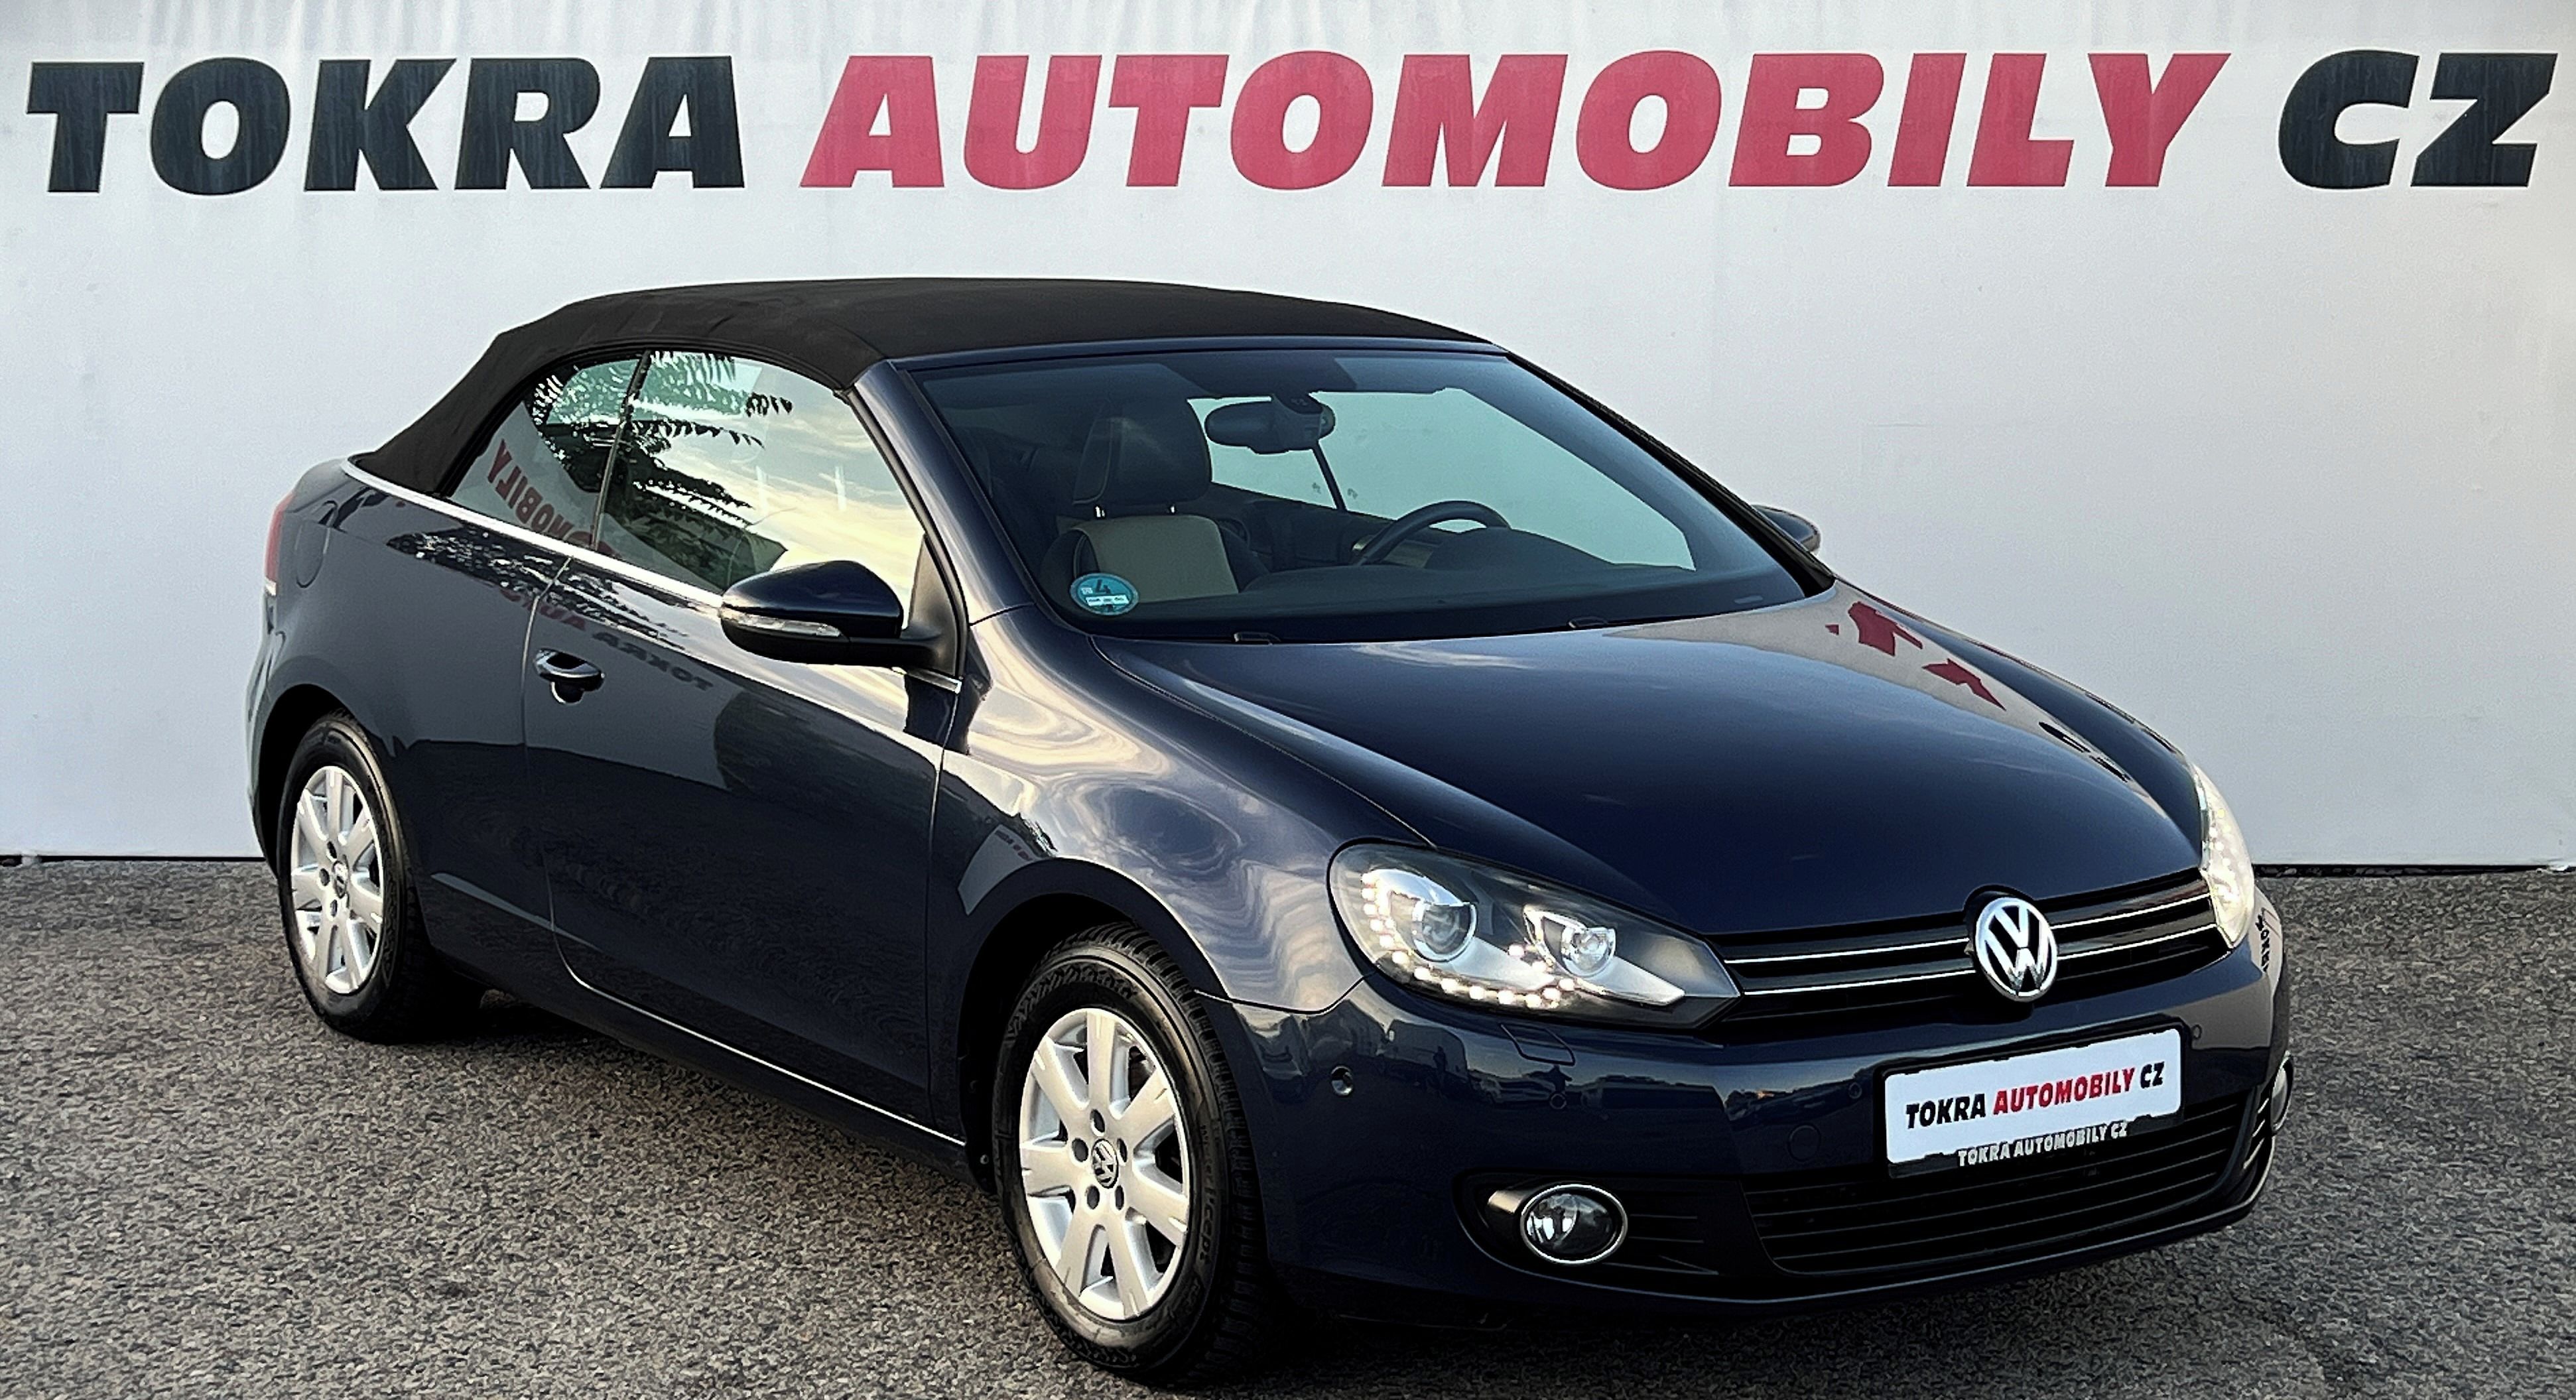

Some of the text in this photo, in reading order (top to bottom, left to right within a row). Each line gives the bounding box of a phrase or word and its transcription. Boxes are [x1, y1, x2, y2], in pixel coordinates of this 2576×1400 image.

[26, 50, 2558, 196] TOKRA AUTOMOBILY CZ
[1905, 1060, 2165, 1129] TOKRA AUTOMOBILY CZ
[1957, 1121, 2128, 1167] TOKRA AUTOMOBILY CZ
